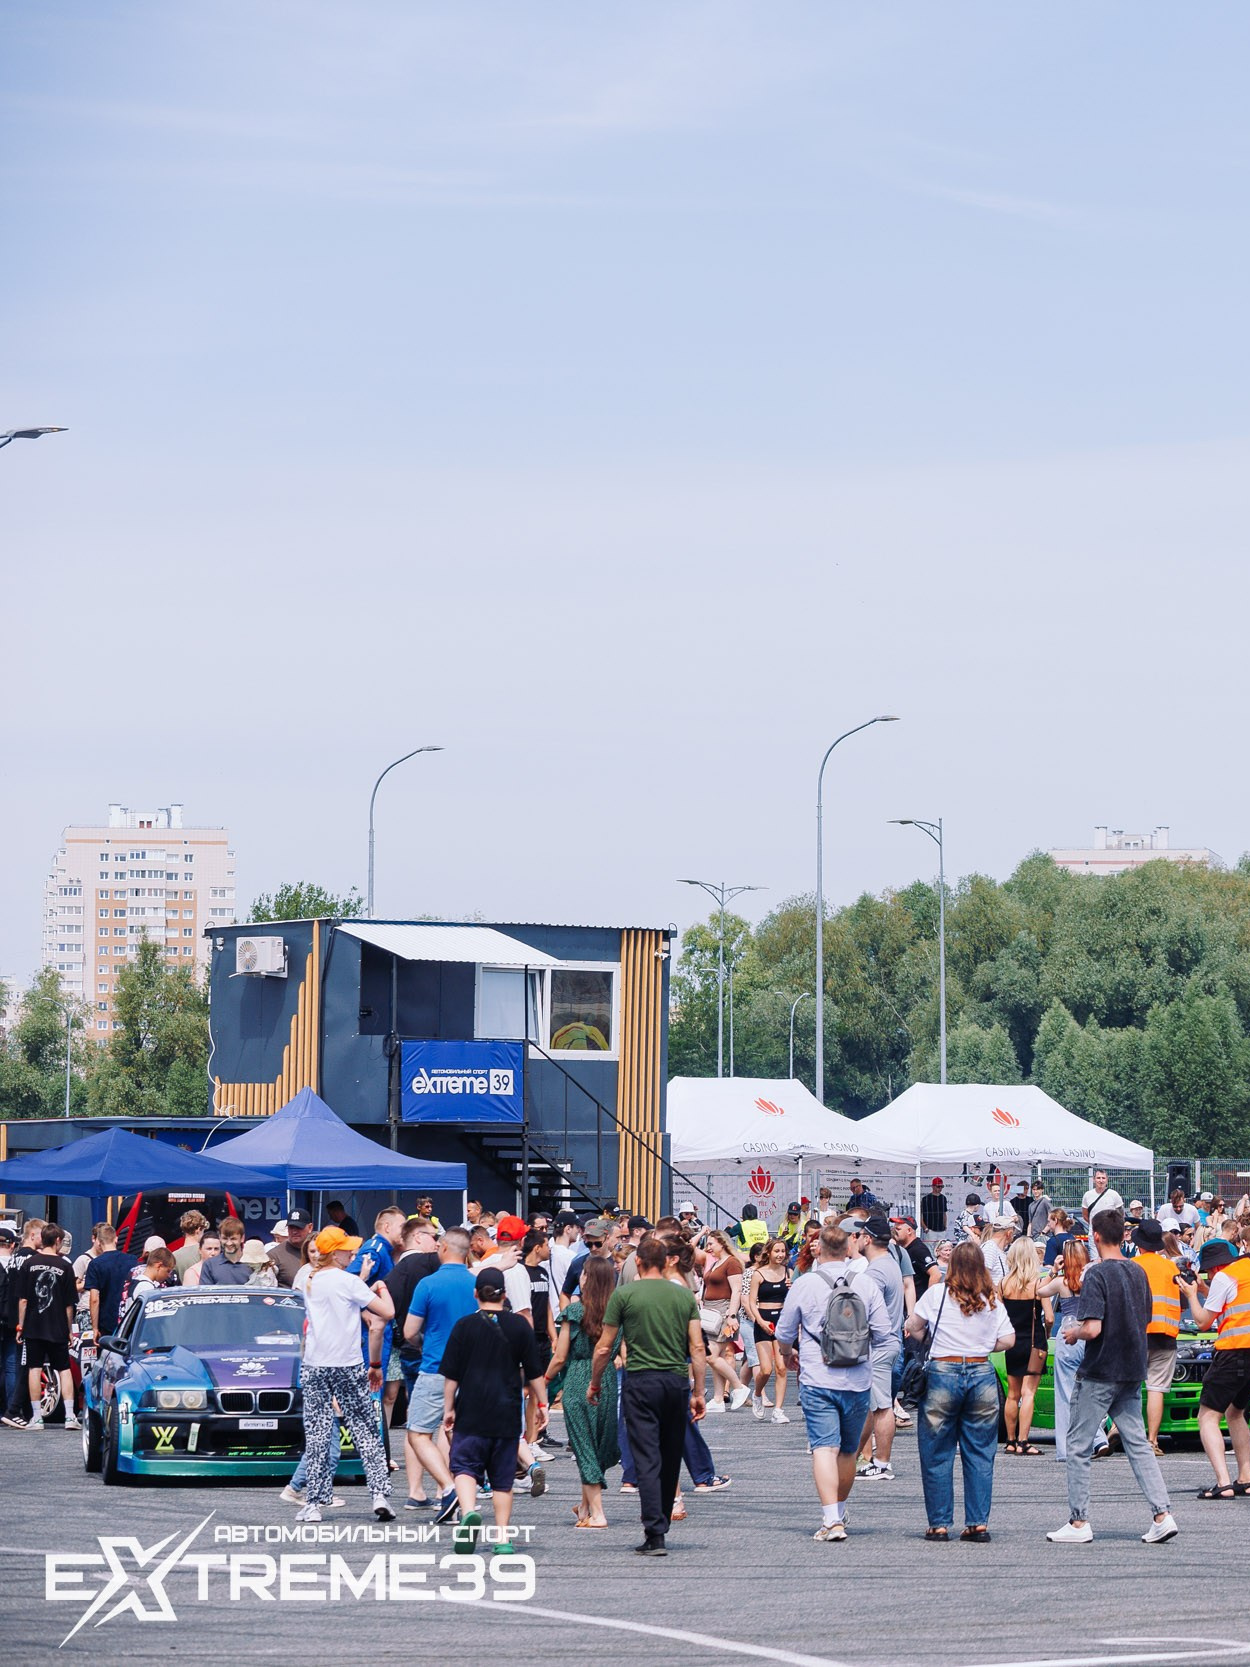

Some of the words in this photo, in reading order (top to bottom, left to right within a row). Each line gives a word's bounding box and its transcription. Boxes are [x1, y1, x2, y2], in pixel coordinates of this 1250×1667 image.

[493, 1074, 510, 1092] 39
[742, 1142, 779, 1153] CASINO
[823, 1142, 859, 1153] CASINO
[985, 1146, 1021, 1157] CASINO
[1062, 1148, 1096, 1159] CASINO
